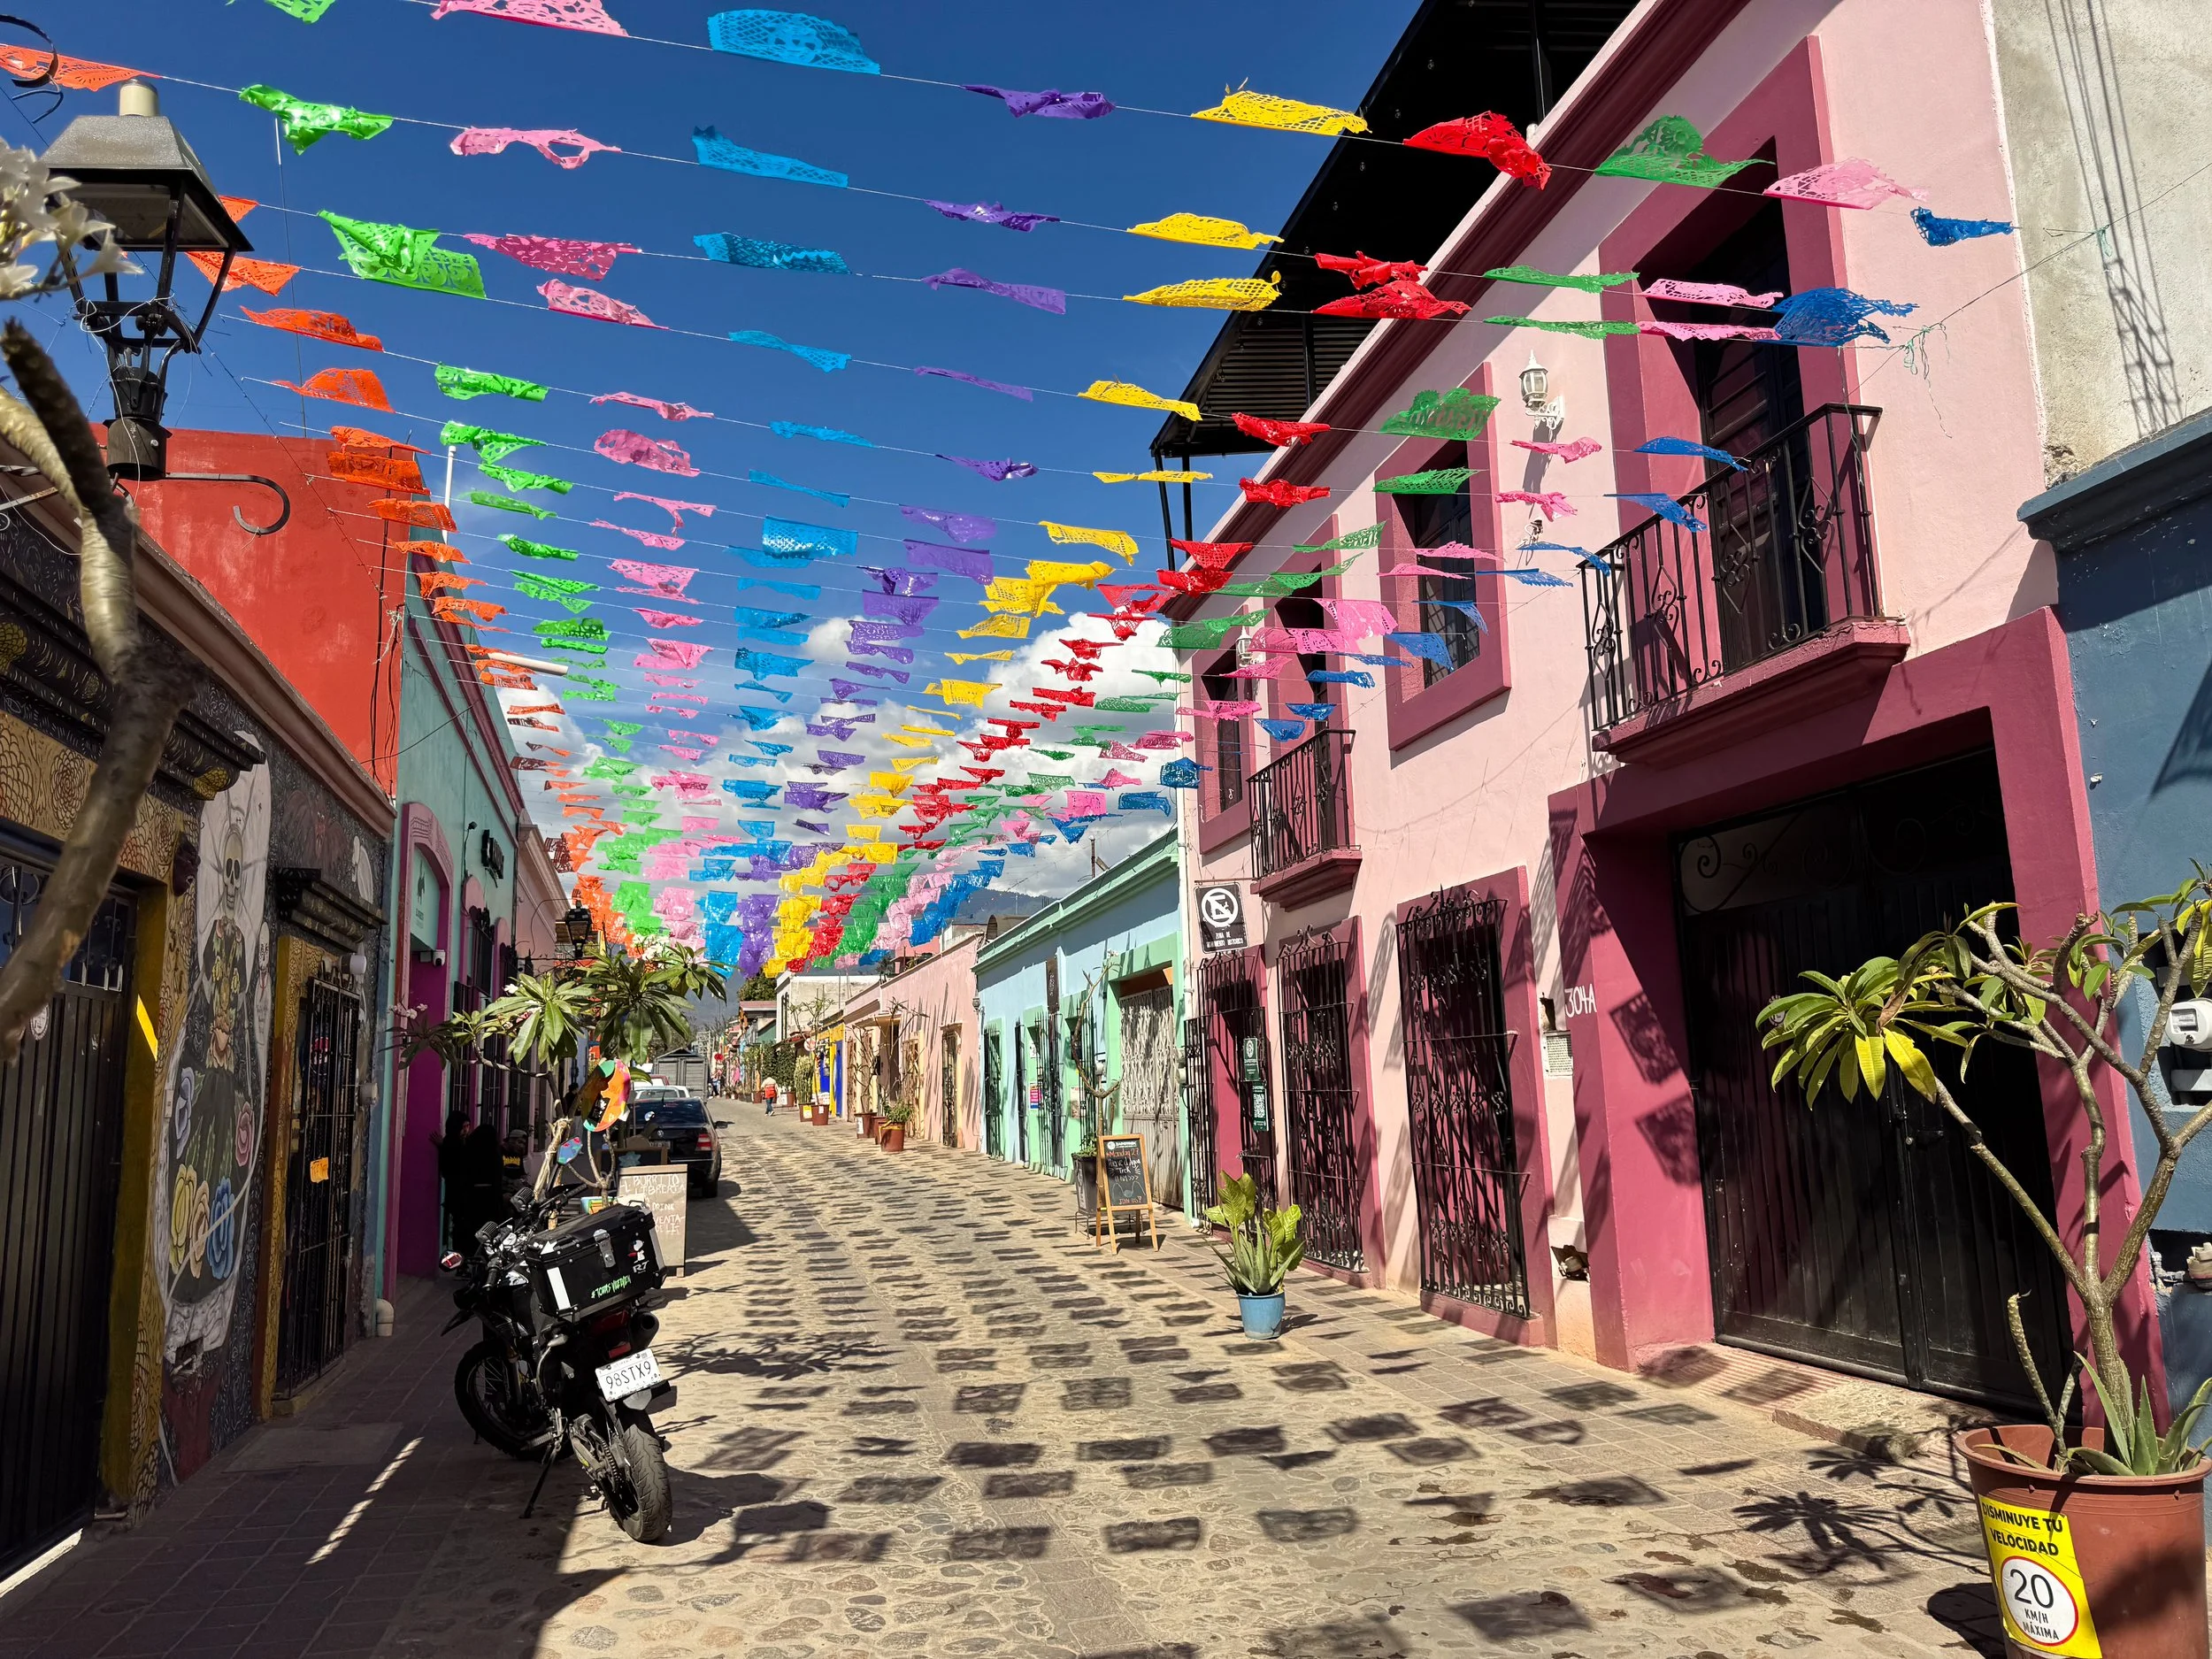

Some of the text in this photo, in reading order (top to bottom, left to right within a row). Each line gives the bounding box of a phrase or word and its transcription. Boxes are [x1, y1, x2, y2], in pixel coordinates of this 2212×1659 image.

[1564, 983, 1597, 1018] 304A
[633, 1174, 680, 1187] BURRITO
[652, 1202, 674, 1210] DRINK
[605, 1360, 652, 1390] 98STX9
[1982, 1502, 2063, 1533] DISMINUYE TU
[1990, 1526, 2059, 1556] VELOCIDAD
[2009, 1568, 2055, 1609] 20
[2023, 1621, 2060, 1640] MÁXIMA
[2024, 1608, 2048, 1624] KM/H
